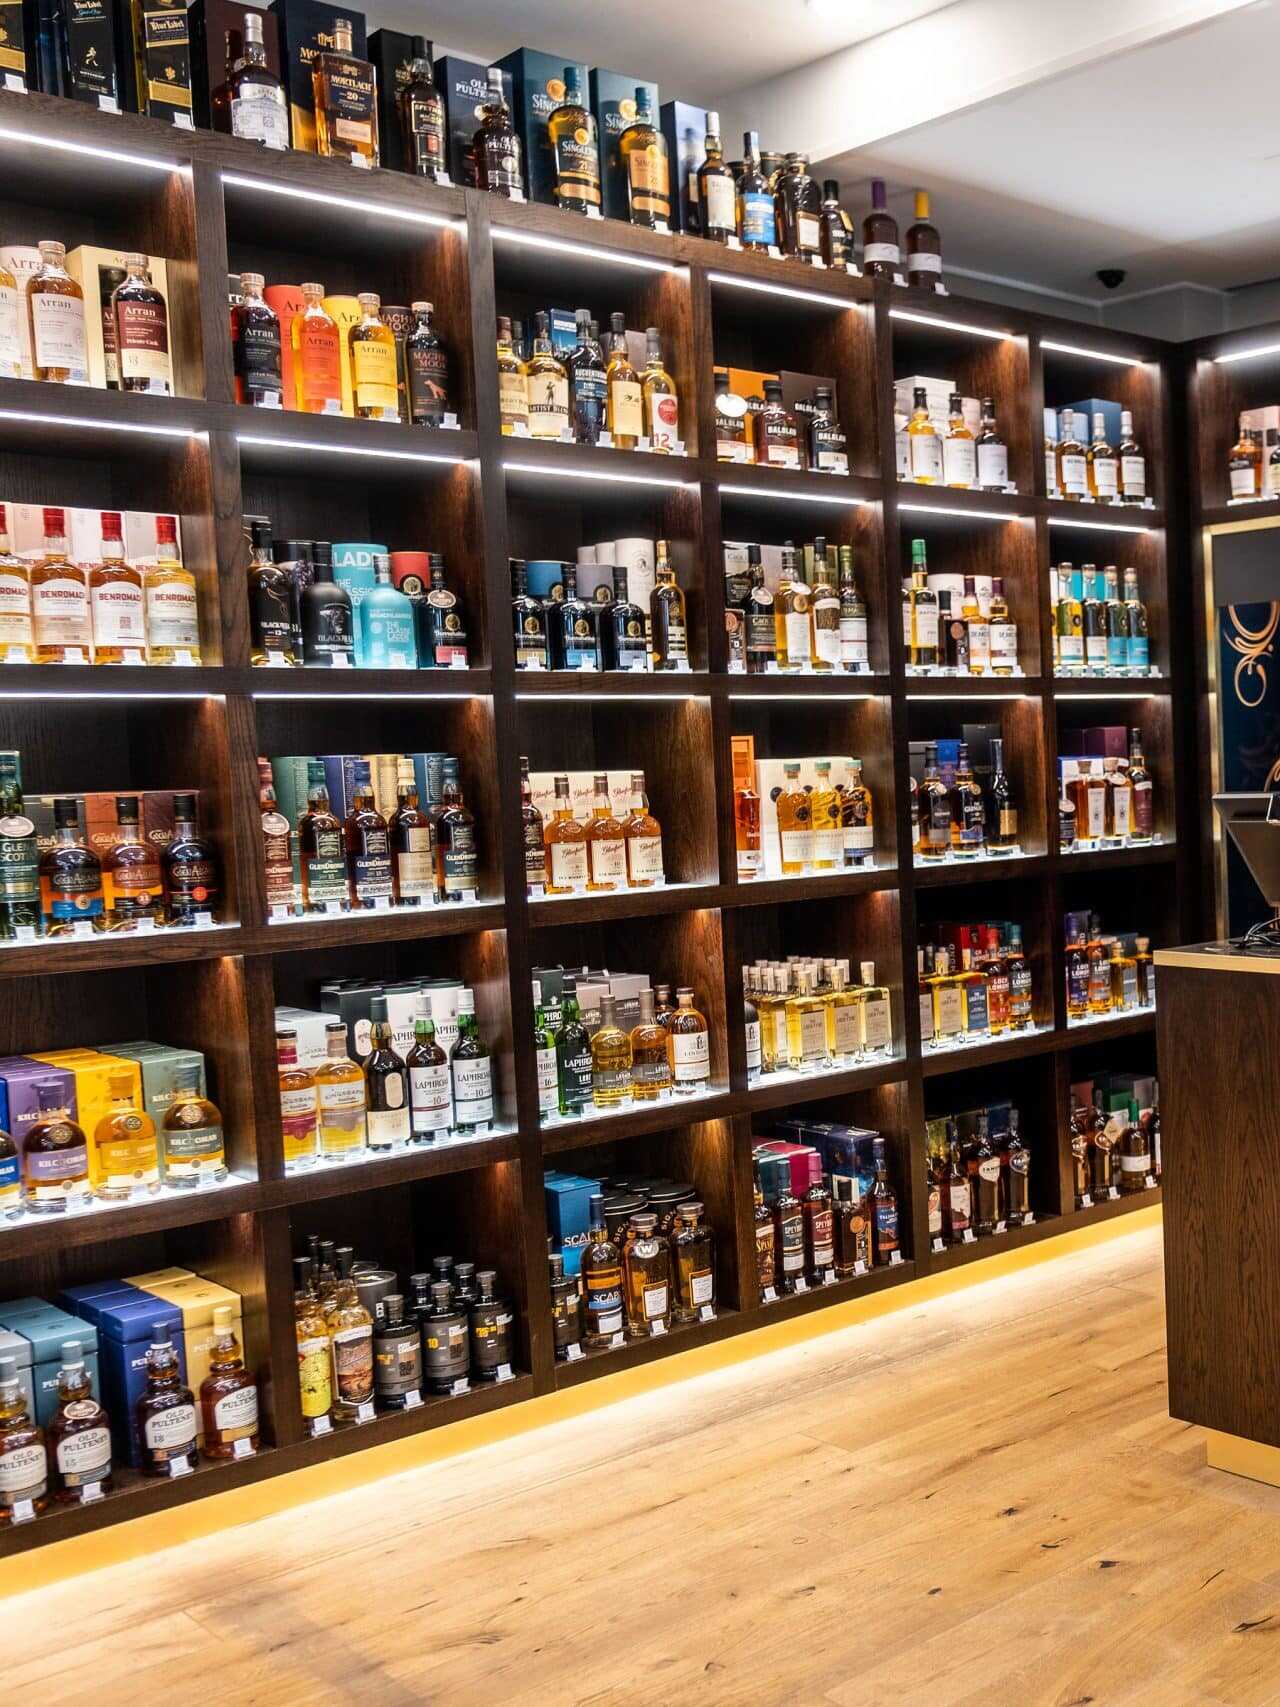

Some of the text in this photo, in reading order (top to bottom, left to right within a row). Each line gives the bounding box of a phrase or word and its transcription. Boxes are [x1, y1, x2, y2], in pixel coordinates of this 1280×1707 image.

[166, 20, 184, 28] Label
[331, 75, 372, 90] MORTLACH
[346, 92, 358, 101] 20
[39, 298, 71, 309] Arran
[125, 305, 155, 316] Arran
[245, 327, 274, 338] Arran
[306, 336, 334, 346] Arran
[360, 345, 387, 354] Arran
[654, 433, 670, 447] 12
[165, 1408, 185, 1419] OLD
[78, 1432, 97, 1442] OLD
[154, 1434, 164, 1443] 18
[13, 1450, 32, 1461] OLD
